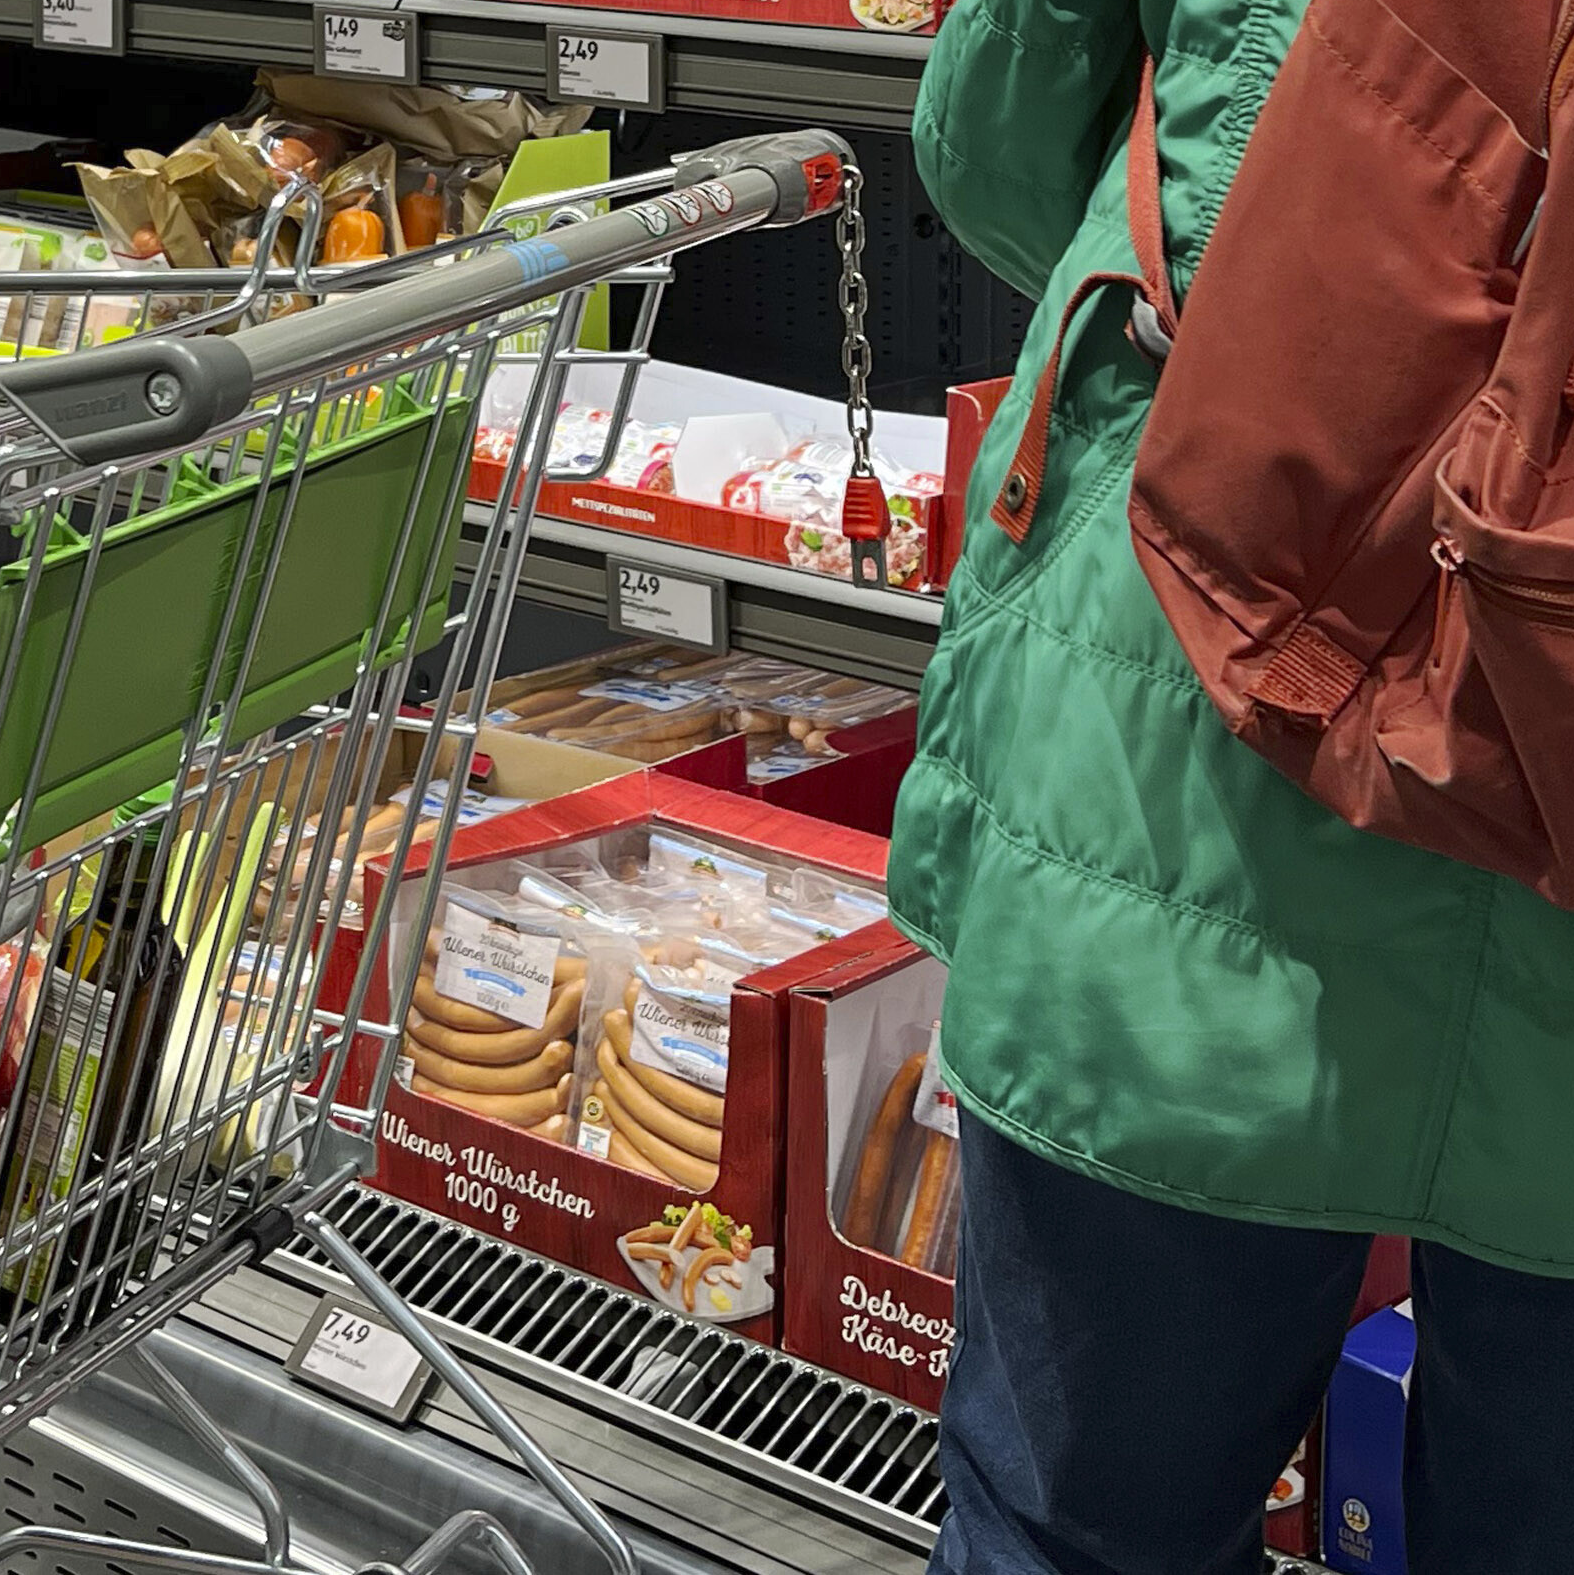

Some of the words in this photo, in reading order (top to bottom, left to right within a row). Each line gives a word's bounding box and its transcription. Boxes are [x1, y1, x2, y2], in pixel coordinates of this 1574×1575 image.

[325, 17, 359, 40] 1,49
[558, 37, 599, 62] 2,49
[618, 569, 660, 596] 2,49
[443, 936, 486, 965] Wiener
[489, 951, 551, 986] Würstchen
[639, 1002, 687, 1032] Wiener
[381, 1111, 457, 1167] Wiener
[460, 1144, 596, 1220] Würstchen
[444, 1172, 498, 1214] 1000
[502, 1204, 520, 1232] g
[323, 1311, 370, 1344] 7,49
[839, 1274, 957, 1347] Debrecz
[842, 1313, 950, 1378] Käse-K
